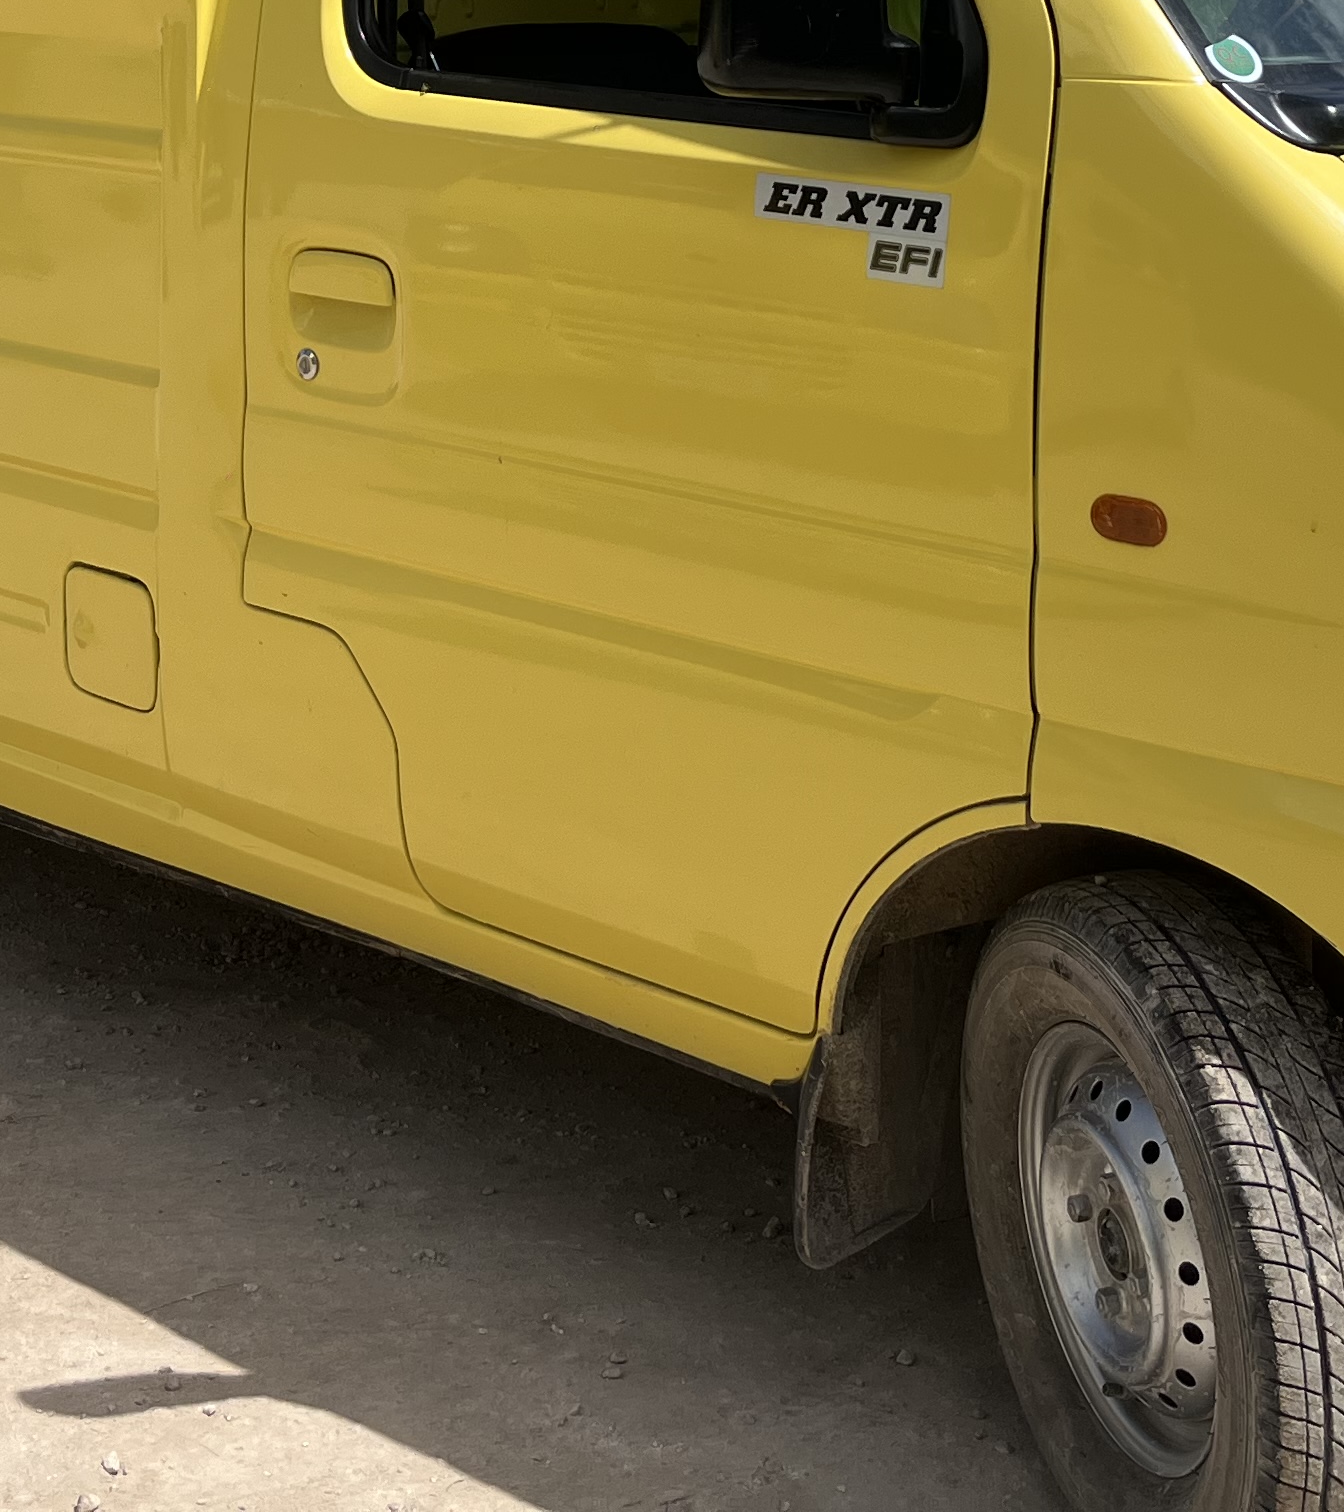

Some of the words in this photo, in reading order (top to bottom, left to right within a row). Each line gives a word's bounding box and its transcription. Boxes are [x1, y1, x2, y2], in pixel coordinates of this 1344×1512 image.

[762, 181, 829, 219] ER
[835, 190, 943, 234] XTR
[869, 239, 944, 278] EFI
